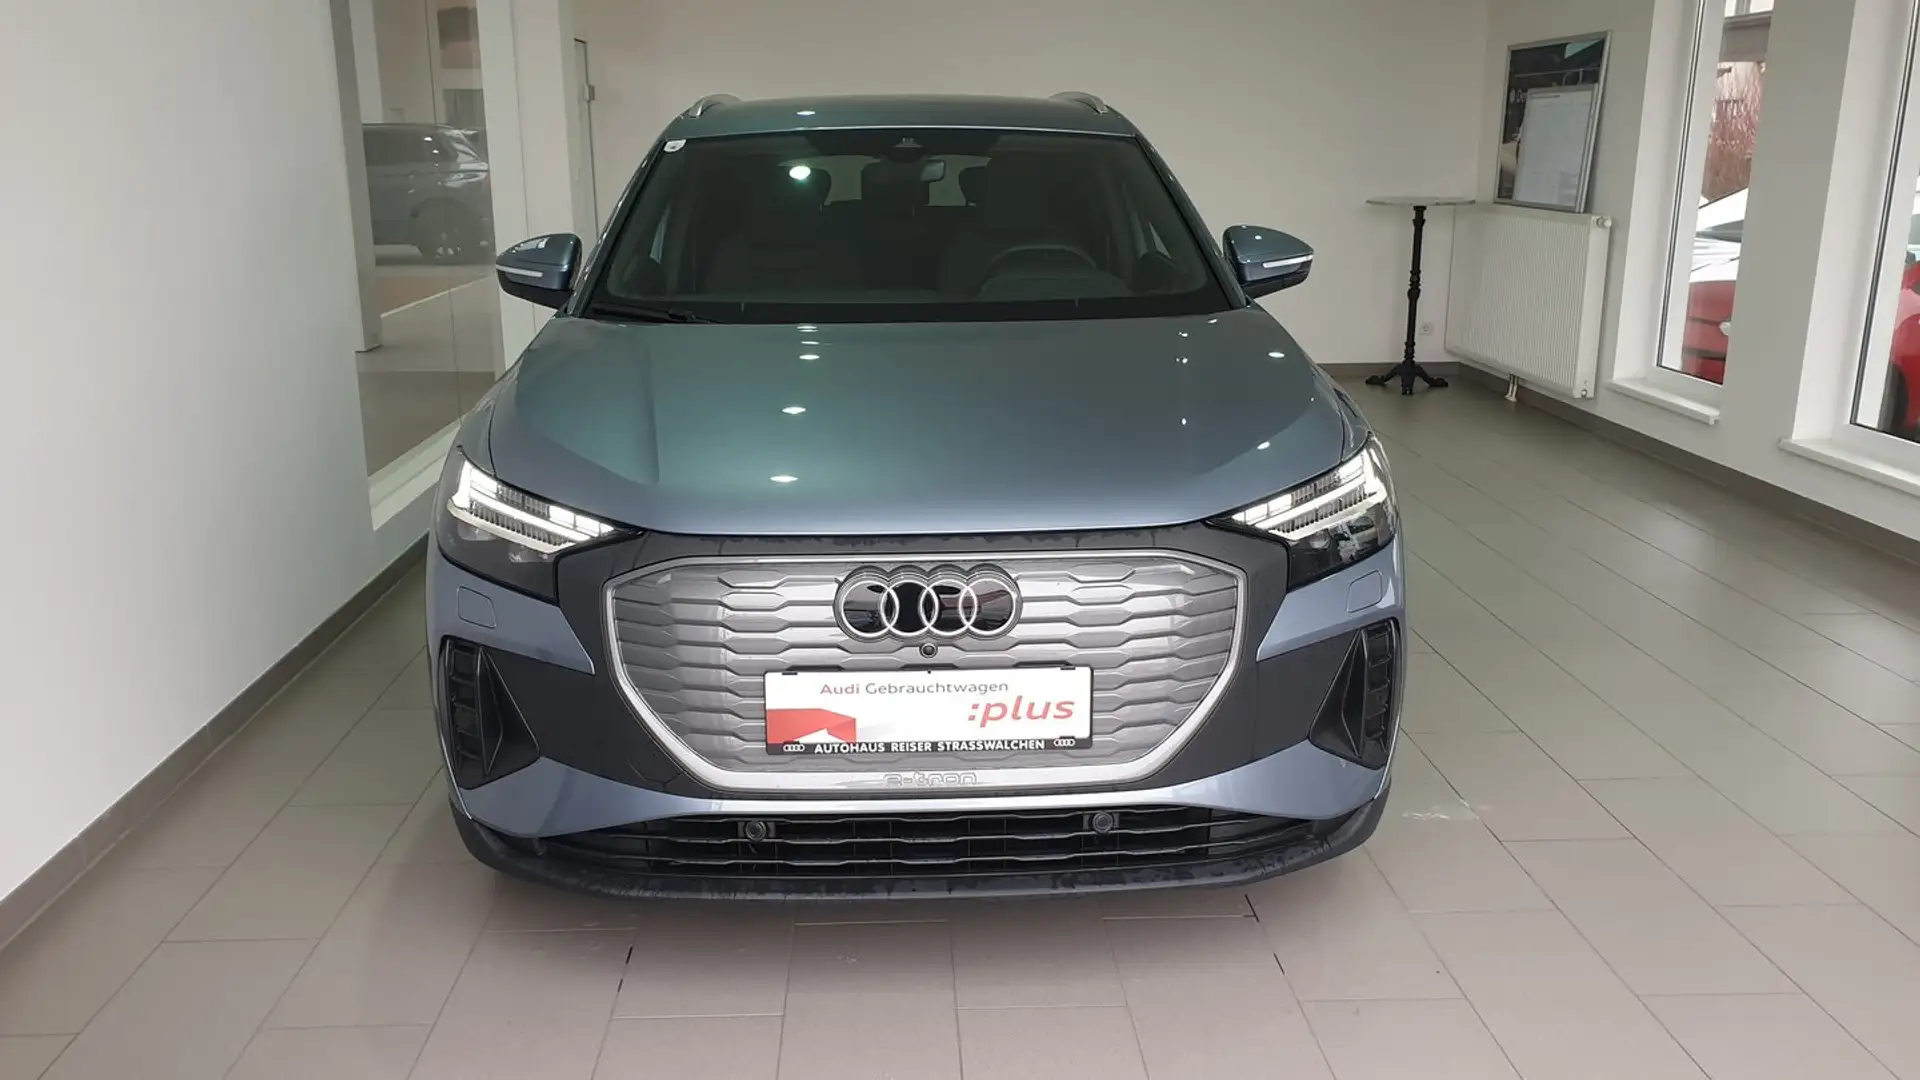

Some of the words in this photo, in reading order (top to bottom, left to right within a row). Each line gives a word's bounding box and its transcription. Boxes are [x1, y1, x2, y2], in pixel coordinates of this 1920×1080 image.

[819, 683, 860, 695] Audi
[865, 681, 1009, 695] Gebrauchtwagen
[967, 695, 1075, 728] :plus
[814, 742, 886, 754] AUTOHAUS
[890, 741, 933, 752] REISER
[937, 738, 1046, 751] STRASSWALCHEN
[883, 771, 977, 787] e-tron
